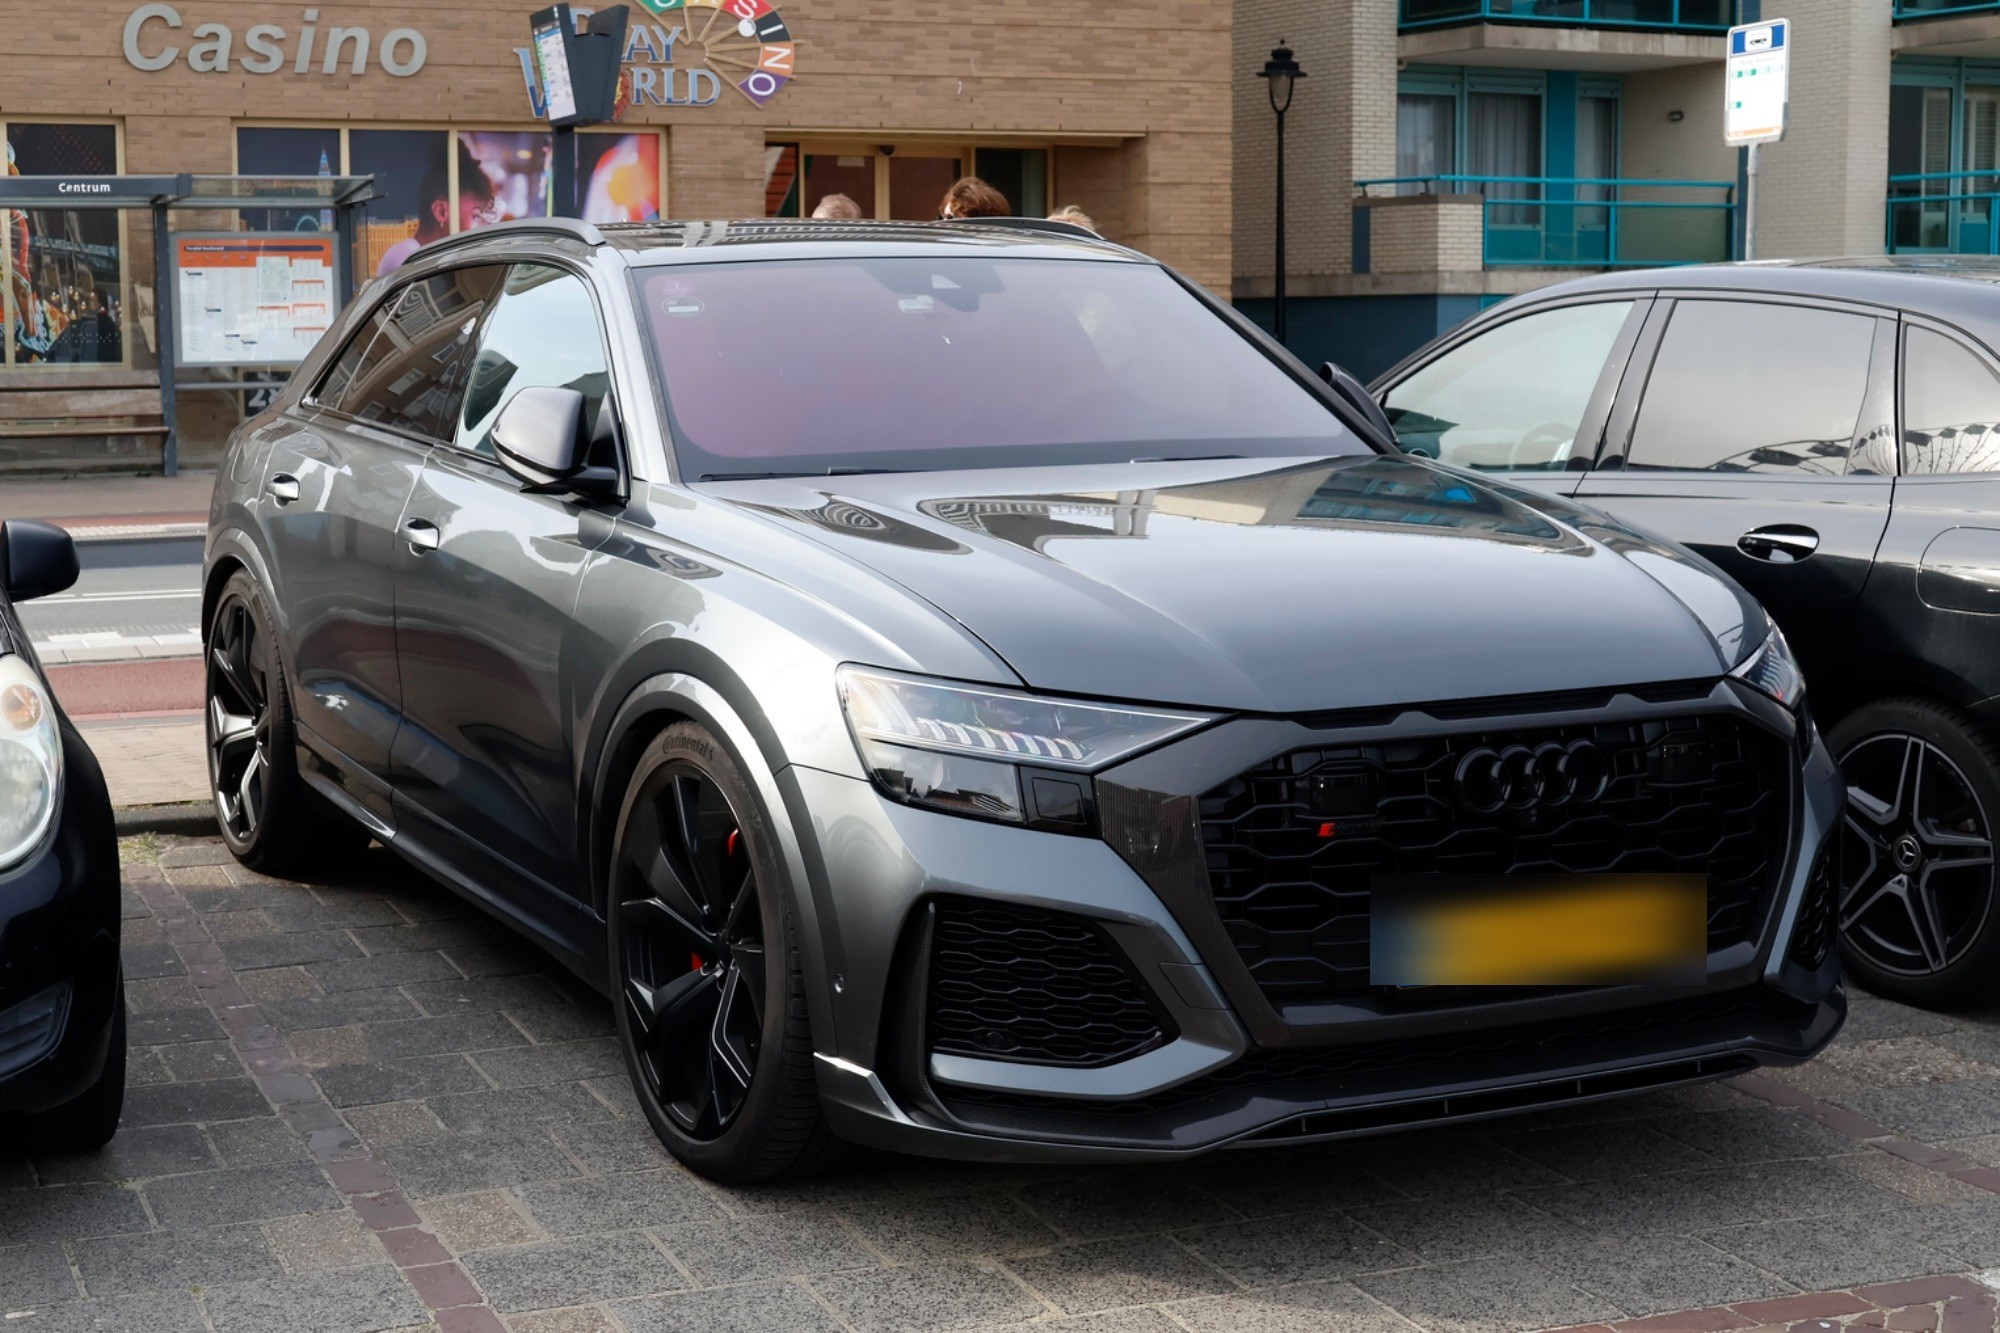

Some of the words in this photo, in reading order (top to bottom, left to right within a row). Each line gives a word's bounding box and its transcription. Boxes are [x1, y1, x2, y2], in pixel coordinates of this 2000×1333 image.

[122, 3, 428, 77] Casino
[654, 0, 792, 96] SINO
[58, 181, 111, 193] Centrum
[662, 734, 709, 758] Continental
